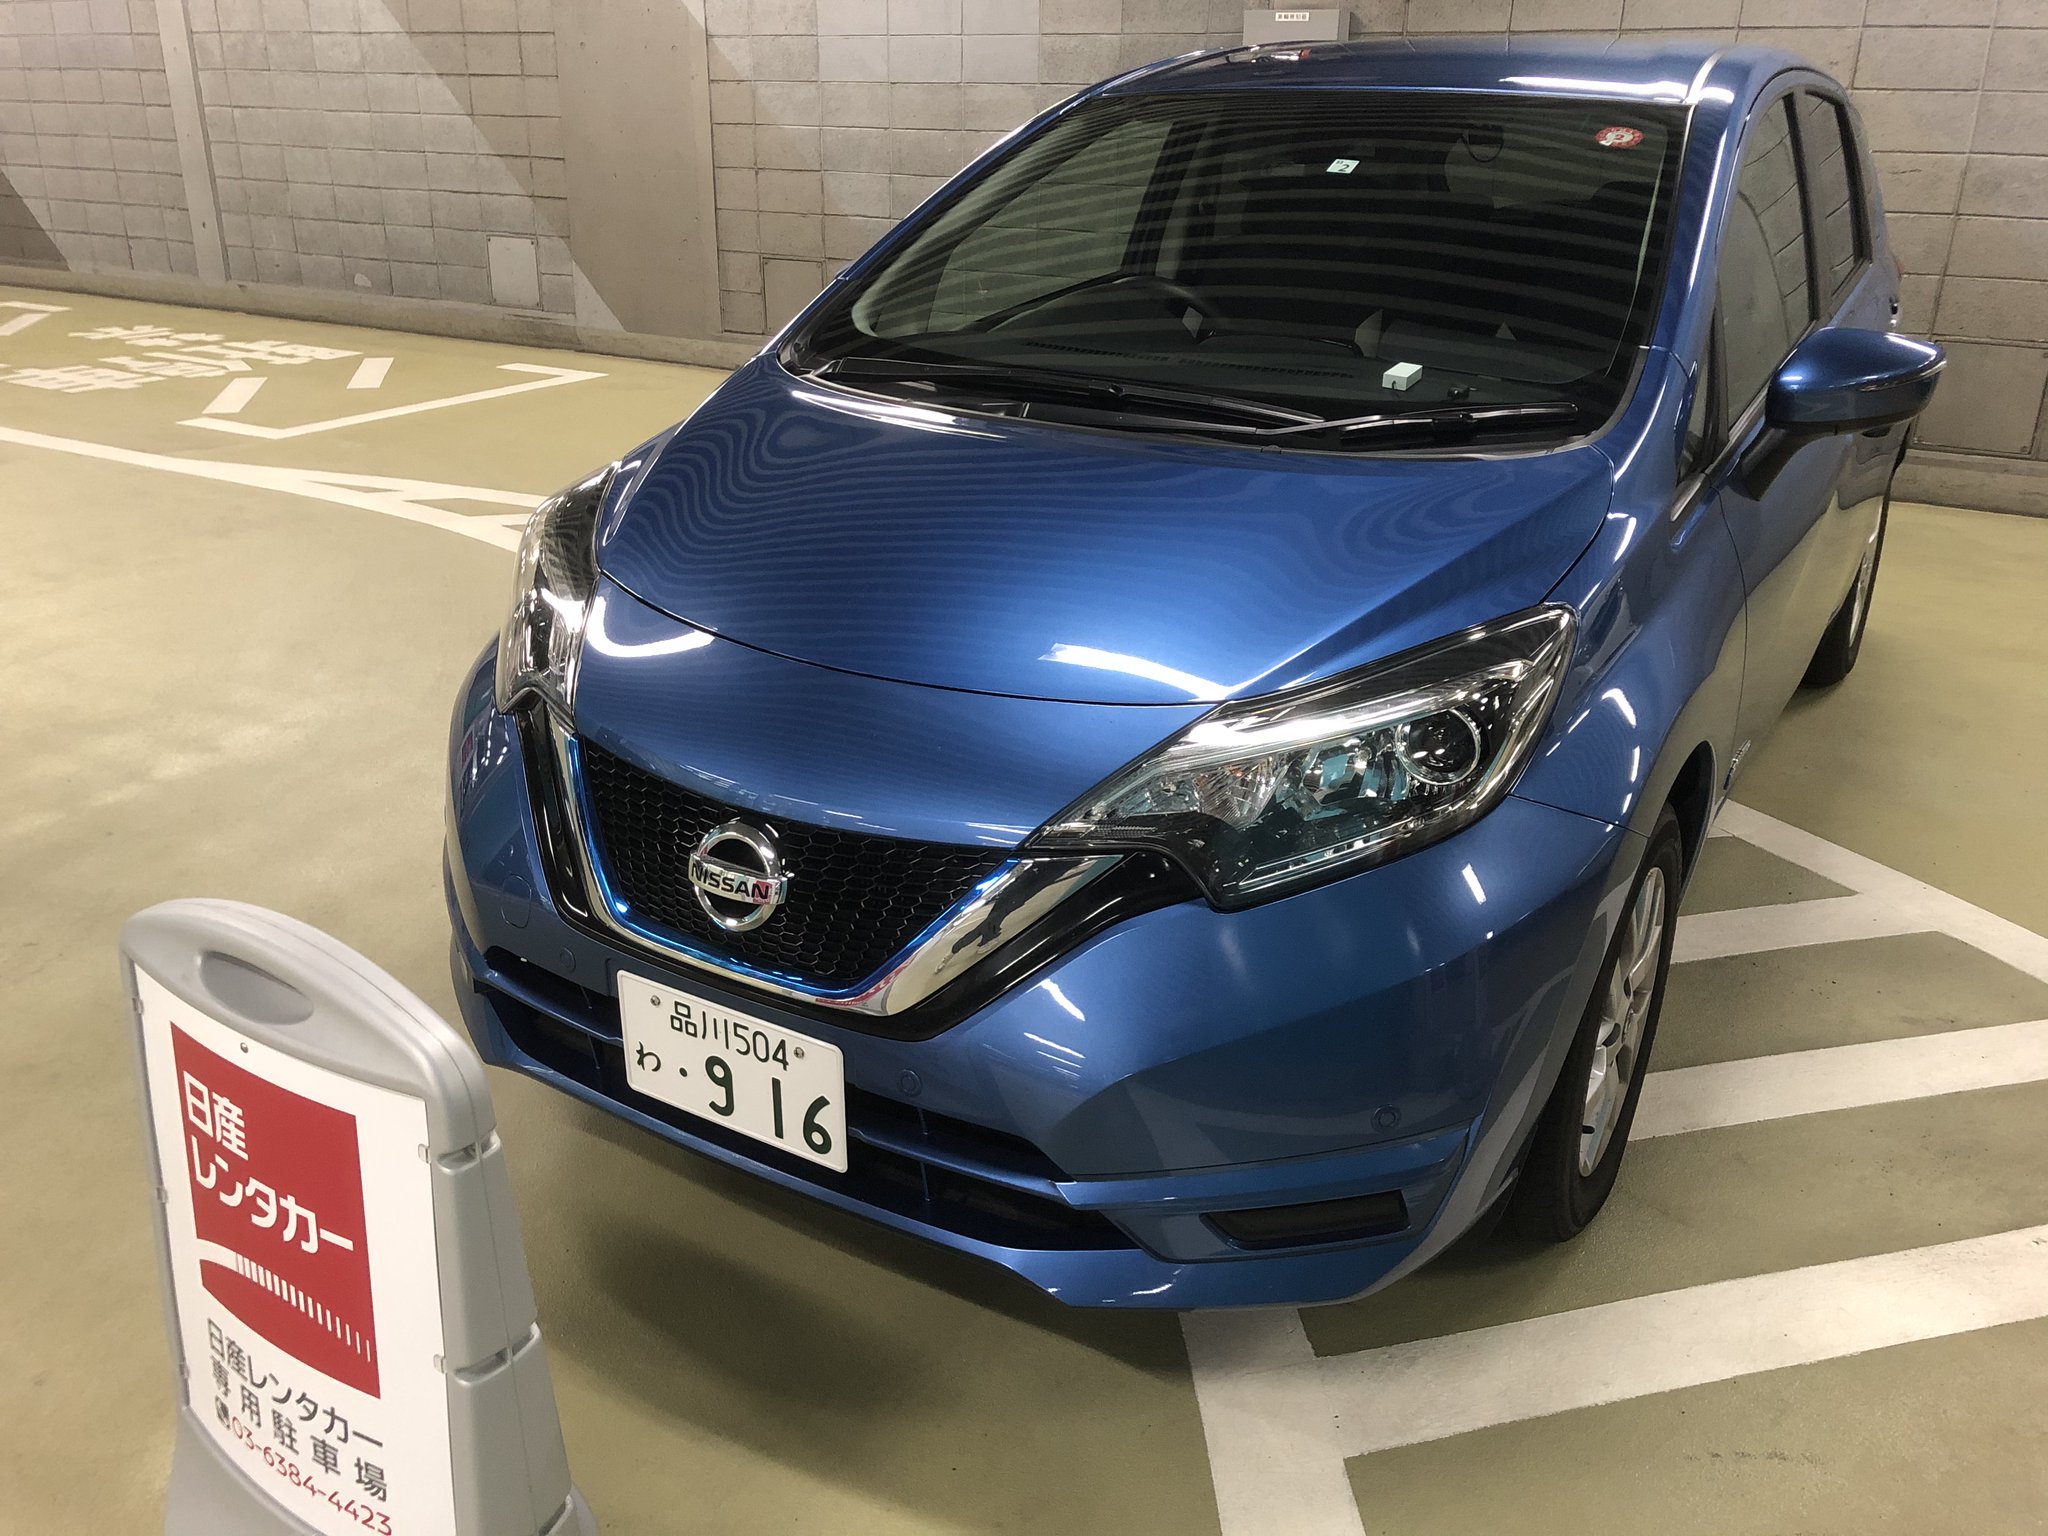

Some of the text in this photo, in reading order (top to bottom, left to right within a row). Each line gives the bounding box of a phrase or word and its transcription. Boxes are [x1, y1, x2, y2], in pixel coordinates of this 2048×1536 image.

[690, 861, 771, 901] NISSAN
[636, 1040, 662, 1073] わ
[181, 1069, 249, 1161] 日産
[189, 1136, 354, 1254] レンタカー
[207, 1318, 384, 1448] 日産レンタカー
[231, 1416, 393, 1536] 03-6384-4423
